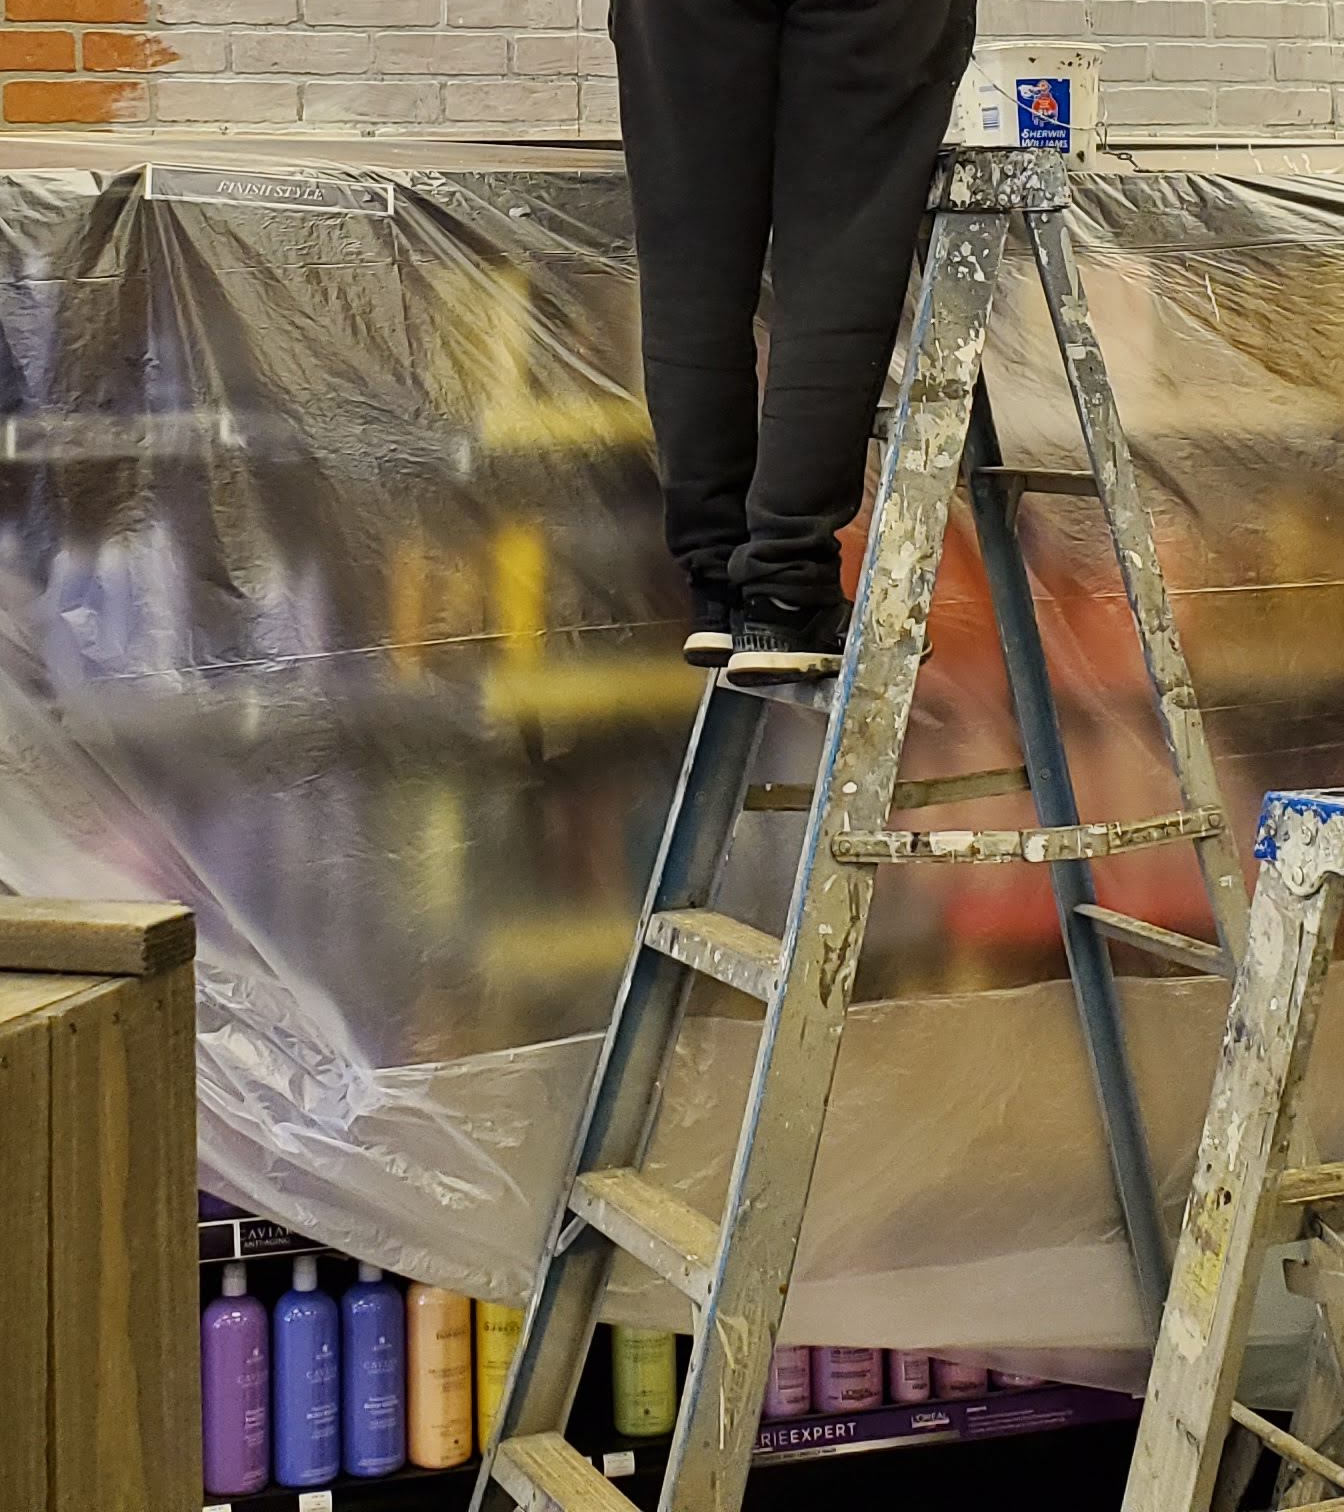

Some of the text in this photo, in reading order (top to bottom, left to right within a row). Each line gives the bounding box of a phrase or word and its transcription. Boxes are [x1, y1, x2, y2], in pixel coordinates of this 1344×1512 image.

[1021, 128, 1066, 139] SHERWIN
[1021, 138, 1069, 148] WILLIAMS
[216, 180, 326, 201] FINISH STYLE
